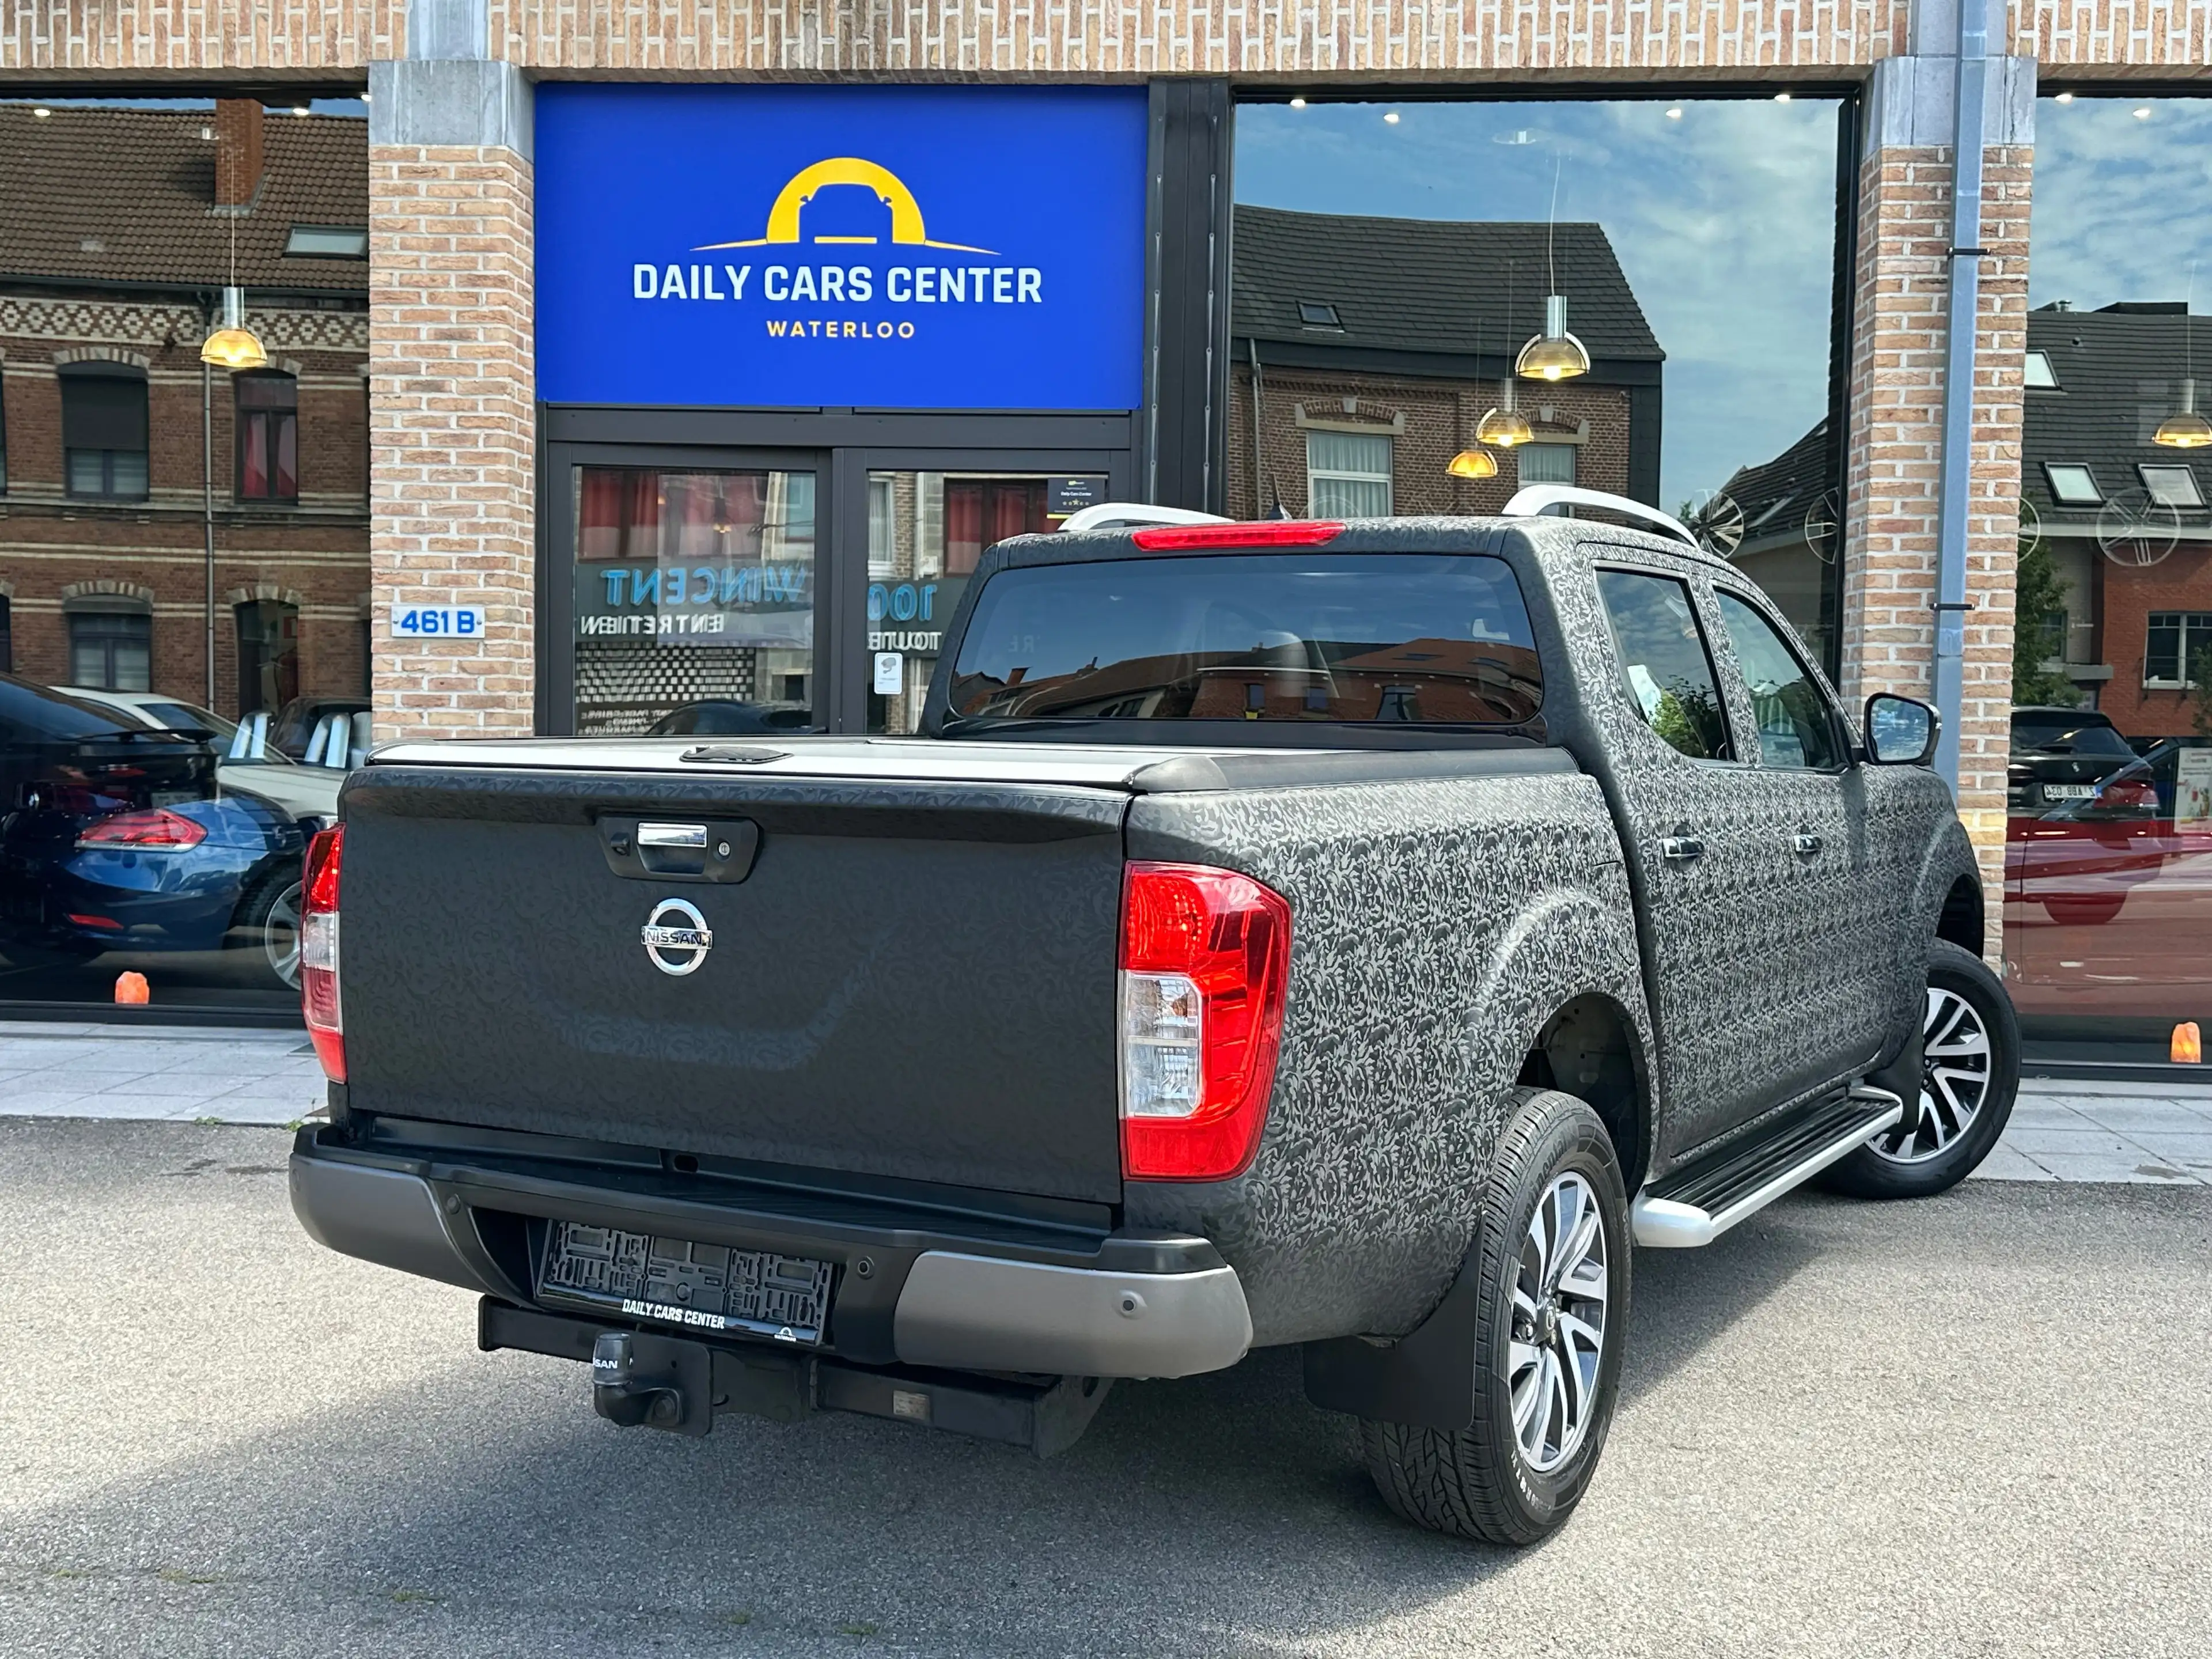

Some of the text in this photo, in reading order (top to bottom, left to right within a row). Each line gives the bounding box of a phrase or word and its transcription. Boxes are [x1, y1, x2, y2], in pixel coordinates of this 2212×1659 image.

[634, 264, 1042, 303] DAILY CARS CENTER
[767, 320, 915, 339] WATERLOO
[401, 610, 475, 633] 461 B
[646, 930, 702, 946] NISSAN
[622, 1298, 725, 1330] DAILY CARS CENTER
